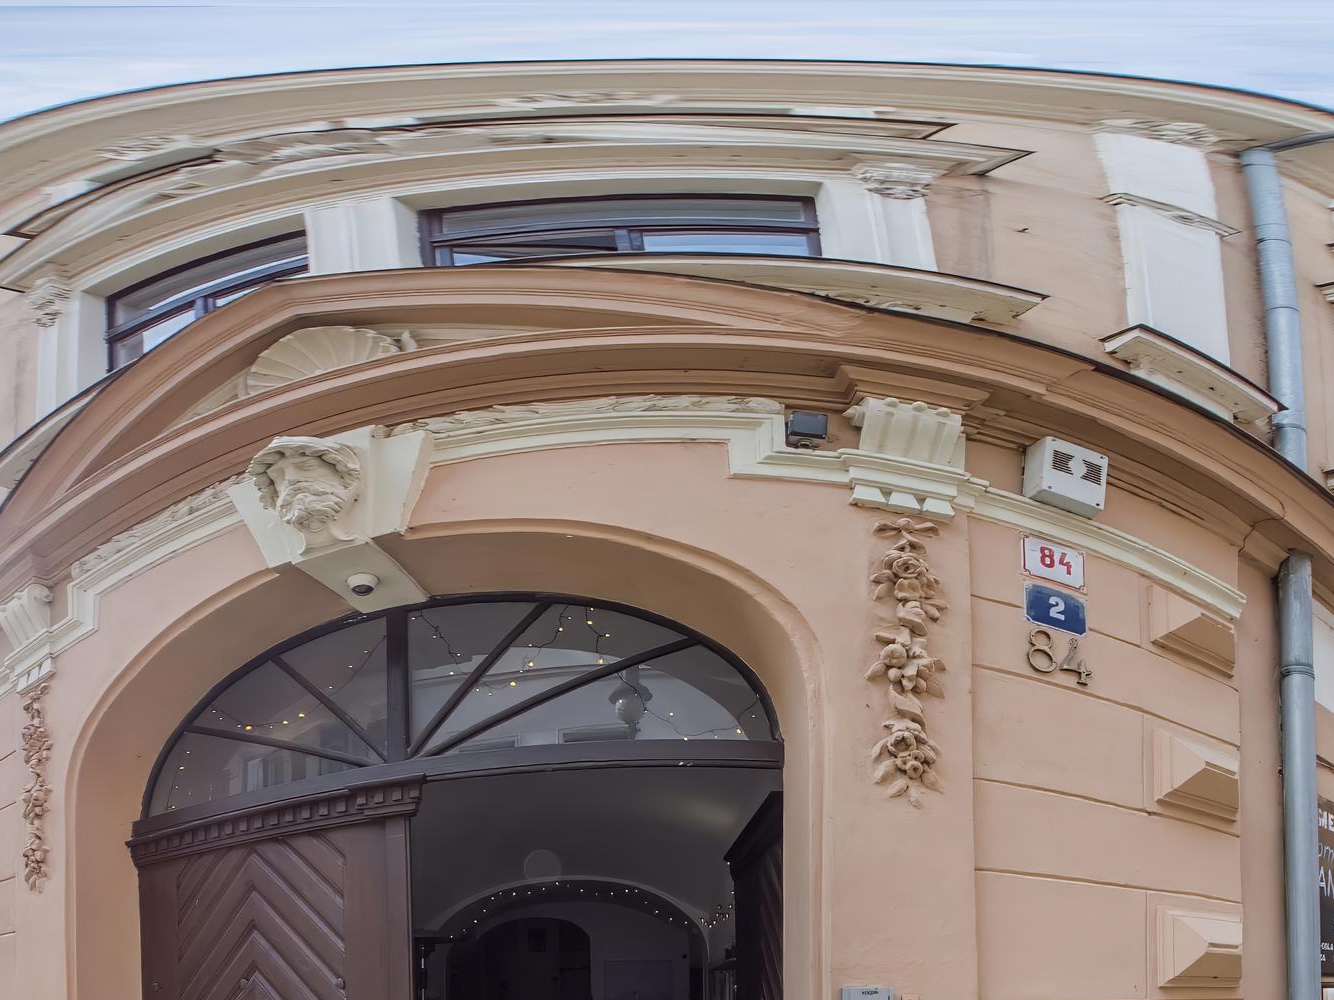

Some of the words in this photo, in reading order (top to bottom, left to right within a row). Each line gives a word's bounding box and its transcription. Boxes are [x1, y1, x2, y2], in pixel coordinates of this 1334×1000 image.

[1039, 546, 1073, 575] 84
[1049, 596, 1065, 621] 2
[1027, 628, 1093, 686] 84
